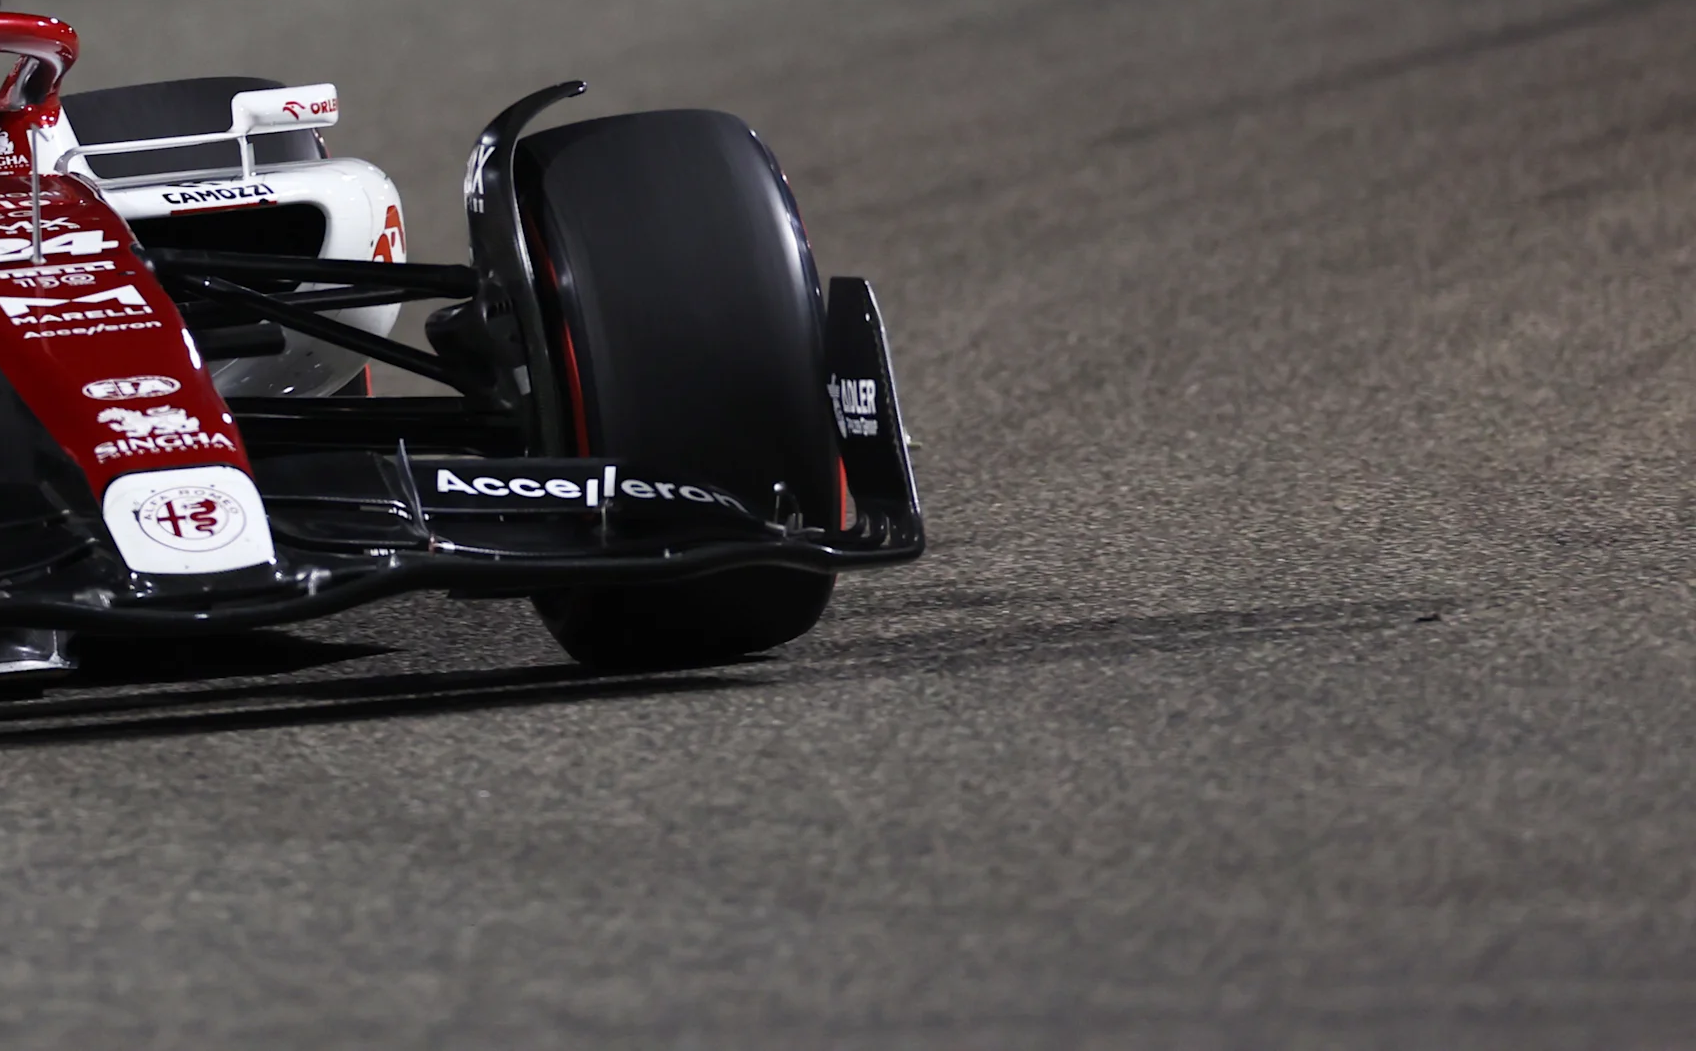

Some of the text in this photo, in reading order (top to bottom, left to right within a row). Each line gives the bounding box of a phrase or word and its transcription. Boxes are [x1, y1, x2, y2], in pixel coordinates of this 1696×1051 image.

[310, 98, 338, 115] ORLE
[162, 183, 274, 204] CAMOZZI
[10, 306, 153, 326] MARELLI
[23, 320, 162, 339] Accelleron
[85, 378, 176, 398] FIA
[94, 432, 235, 458] SINGHA
[437, 465, 750, 514] Accelleron
